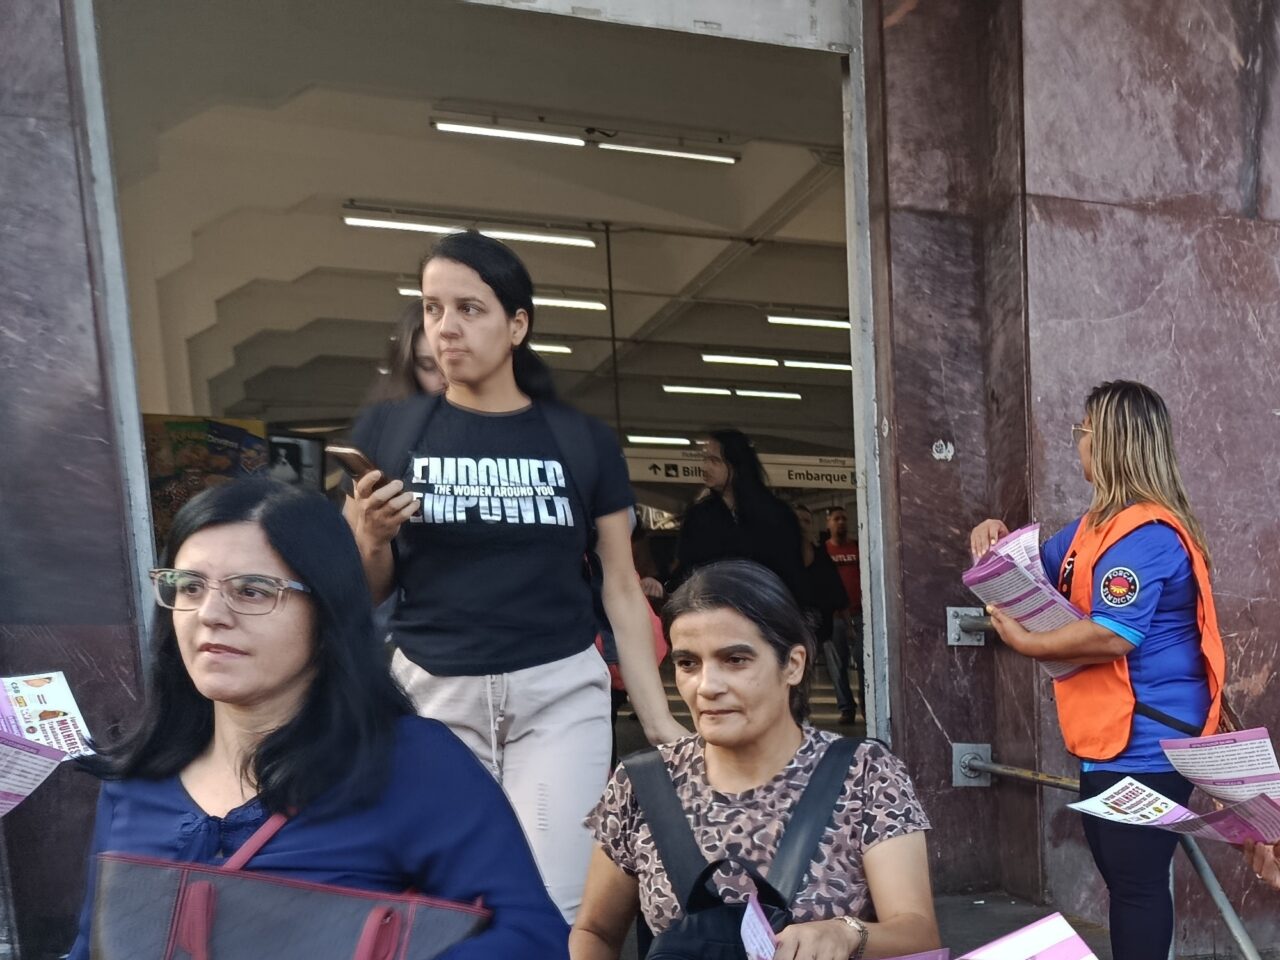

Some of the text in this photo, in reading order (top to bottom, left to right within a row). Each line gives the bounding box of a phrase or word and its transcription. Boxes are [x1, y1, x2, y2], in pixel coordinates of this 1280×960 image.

[682, 466, 705, 478] Bilh
[788, 470, 847, 484] Embarque
[434, 485, 555, 497] THE WOMEN AROUND YOU
[832, 553, 857, 562] UTLET
[1103, 587, 1135, 604] SINDICAL
[56, 719, 81, 755] MULHERES
